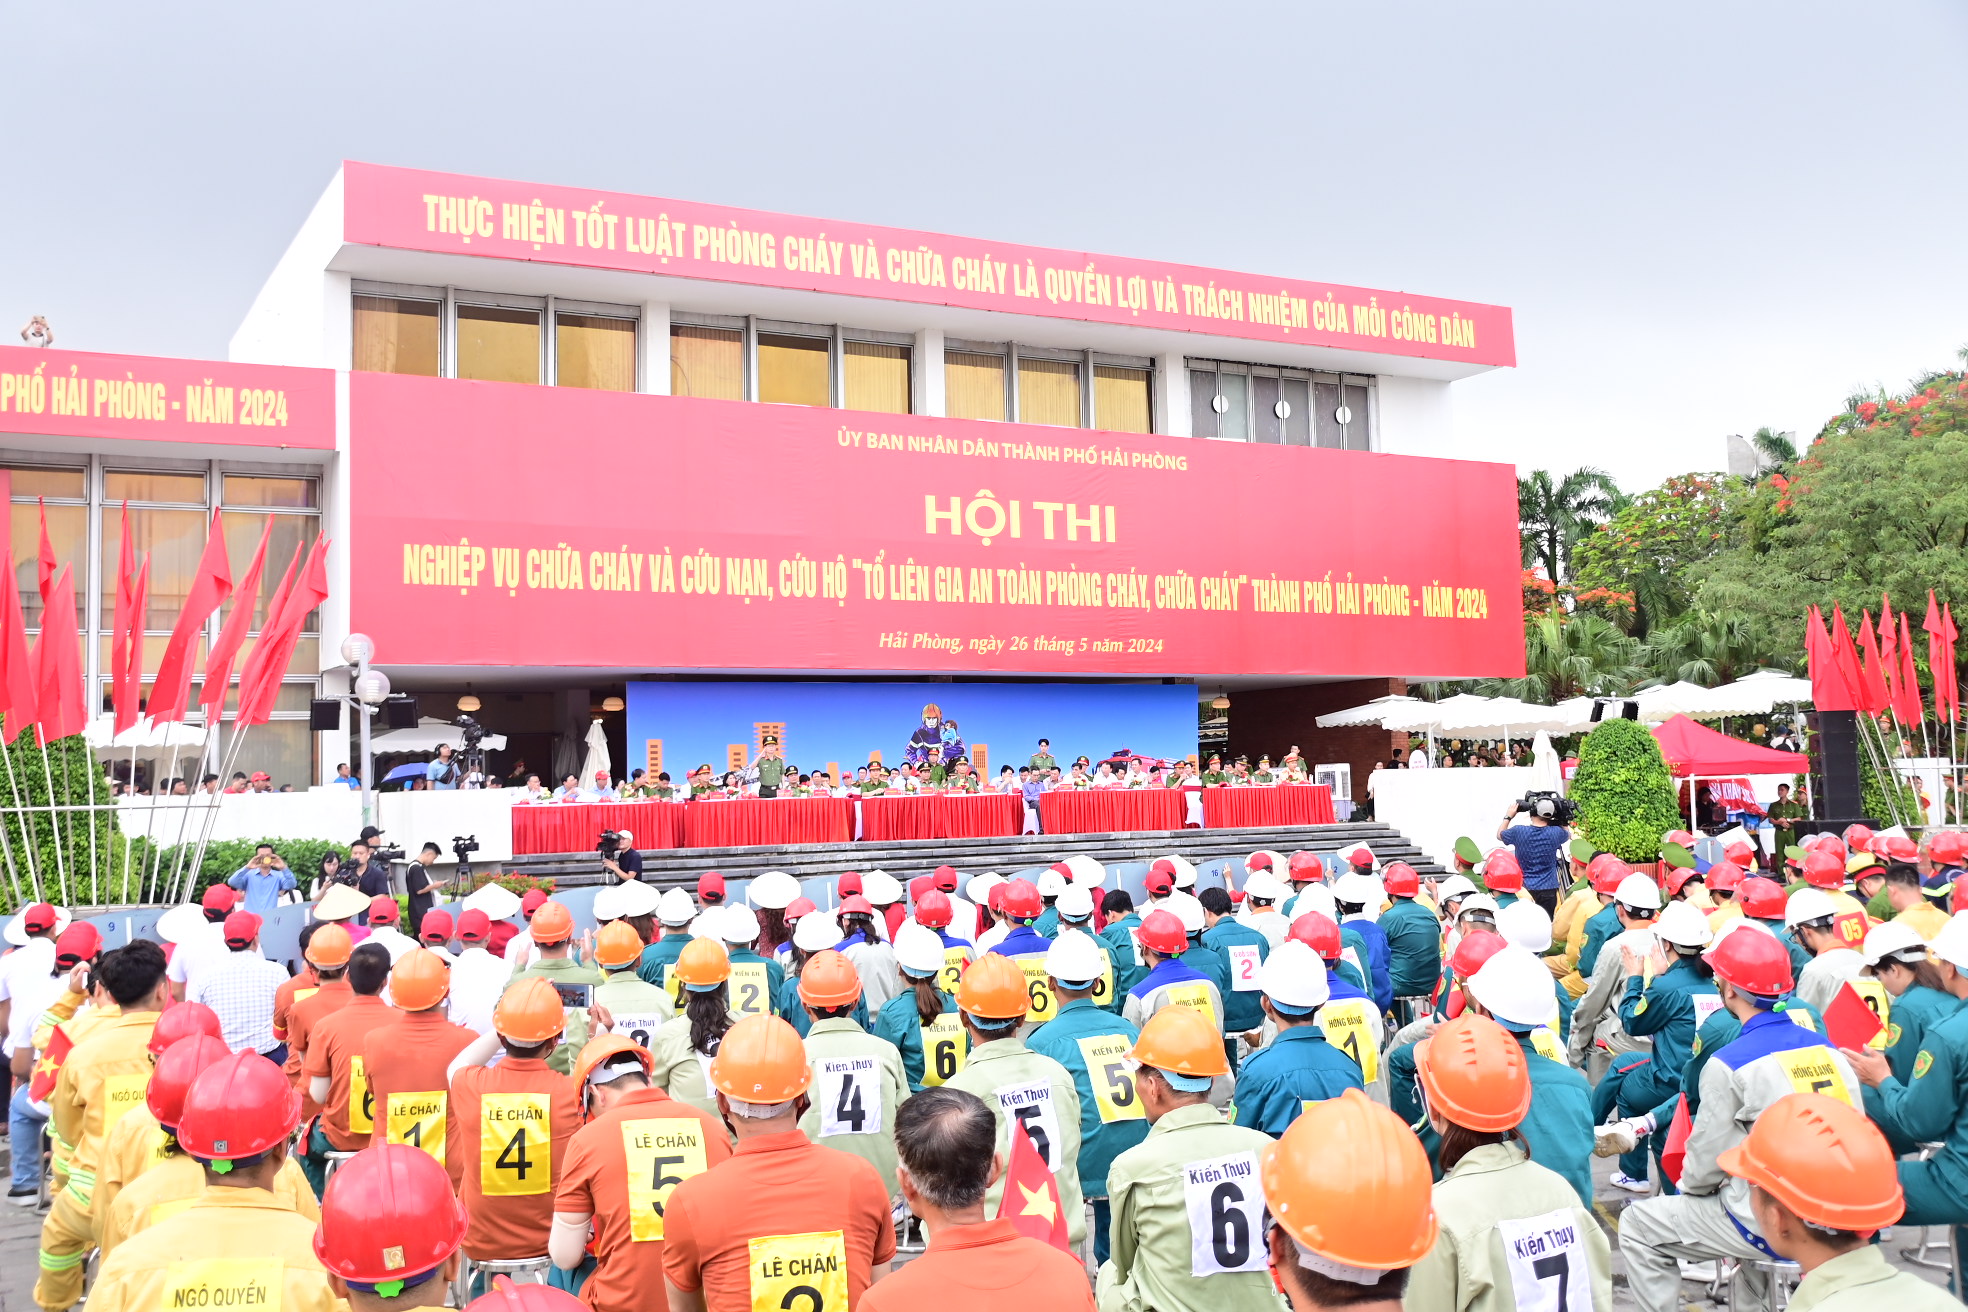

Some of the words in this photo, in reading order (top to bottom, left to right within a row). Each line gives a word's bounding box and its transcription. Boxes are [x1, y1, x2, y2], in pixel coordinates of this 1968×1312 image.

[422, 193, 494, 244] THỰC
[502, 197, 565, 251] HIỆN
[571, 204, 619, 251] TỐT
[625, 212, 687, 265] LUẬT
[692, 221, 777, 269] PHÒNG
[782, 232, 844, 276] CHÁY
[849, 238, 881, 281] VÀ
[886, 245, 947, 289] CHỮA
[951, 253, 1008, 295] CHÁY
[1012, 258, 1040, 299] LÀ
[1044, 265, 1112, 307] QUYỀN
[1115, 274, 1148, 317] LỢI
[1151, 274, 1179, 314] VÀ
[1181, 280, 1245, 322] TRÁCH
[1247, 290, 1309, 334] NHIỆM
[1311, 291, 1350, 335] CỦA
[1351, 296, 1388, 339] MỖI
[1390, 305, 1438, 345] CÔNG
[1439, 311, 1476, 349] DÂN
[0, 361, 47, 414] PHỐ
[51, 364, 88, 417] HẢI
[93, 371, 166, 421] PHÒNG
[186, 378, 234, 425] NĂM
[239, 388, 289, 427] 2024
[837, 425, 863, 448] ỦY
[866, 432, 904, 451] BAN
[907, 434, 959, 455] NHÂN
[962, 437, 999, 458] DÂN
[1000, 441, 1060, 462] THÀNH
[1063, 444, 1098, 465] PHỐ
[1100, 446, 1129, 467] HẢI
[1131, 450, 1188, 471] PHÒNG
[924, 488, 1021, 547] HỘI
[1032, 501, 1116, 543] THI
[403, 537, 486, 596] NGHIỆP
[491, 547, 520, 597] VỤ
[526, 542, 584, 590] CHỮA
[589, 544, 644, 592] CHÁY
[648, 546, 676, 593] VÀ
[680, 547, 721, 595] CỨU
[726, 557, 774, 605] NẠN,
[778, 552, 817, 598] CỨU
[821, 553, 848, 607] HỘ
[852, 548, 885, 601] "TỔ
[889, 557, 930, 602] LIÊN
[934, 565, 965, 603] GIA
[968, 567, 993, 604] AN
[996, 562, 1042, 605] TOÀN
[1045, 563, 1103, 607] PHÒNG
[1106, 566, 1151, 613] CHÁY,
[1154, 569, 1197, 610] CHỮA
[1200, 570, 1248, 611] CHÁY"
[1251, 572, 1301, 613] THÀNH
[1303, 570, 1333, 614] PHỐ
[1335, 571, 1360, 615] HẢI
[1363, 576, 1410, 617] PHÒNG
[1422, 579, 1454, 618] NĂM
[1456, 587, 1488, 619] 2024
[879, 630, 909, 649] Hải
[912, 632, 964, 655] Phòng,
[969, 634, 1006, 655] ngày
[1009, 635, 1029, 651] 26
[1033, 634, 1075, 657] tháng
[1078, 637, 1088, 652] 5
[1092, 638, 1123, 652] năm
[1127, 638, 1163, 653] 2024
[1211, 869, 1219, 877] 16
[108, 922, 115, 932] 9
[1840, 918, 1863, 942] 05
[1241, 959, 1253, 980] 2
[740, 983, 760, 1012] 2
[1029, 980, 1048, 1013] 6
[936, 1040, 956, 1080] 6
[1343, 1031, 1362, 1071] 1
[837, 1073, 866, 1132] 4
[1104, 1063, 1134, 1107] 5
[409, 1102, 440, 1116] CHÂN
[489, 1106, 503, 1121] LÊ
[507, 1106, 543, 1121] CHÂN
[403, 1122, 421, 1149] 1
[635, 1132, 652, 1149] LÊ
[656, 1132, 697, 1148] CHÂN
[1014, 1104, 1050, 1168] 5
[495, 1127, 533, 1181] 4
[652, 1155, 685, 1218] 5
[1189, 1164, 1222, 1185] Kiến
[1220, 1160, 1251, 1180] Thụy
[1211, 1181, 1250, 1269] 6
[1514, 1231, 1546, 1260] Kiến
[1544, 1225, 1575, 1249] Thụy
[762, 1256, 783, 1278] LÊ
[788, 1252, 838, 1277] CHÂN
[1532, 1252, 1569, 1312] 7
[173, 1282, 209, 1308] NGÔ
